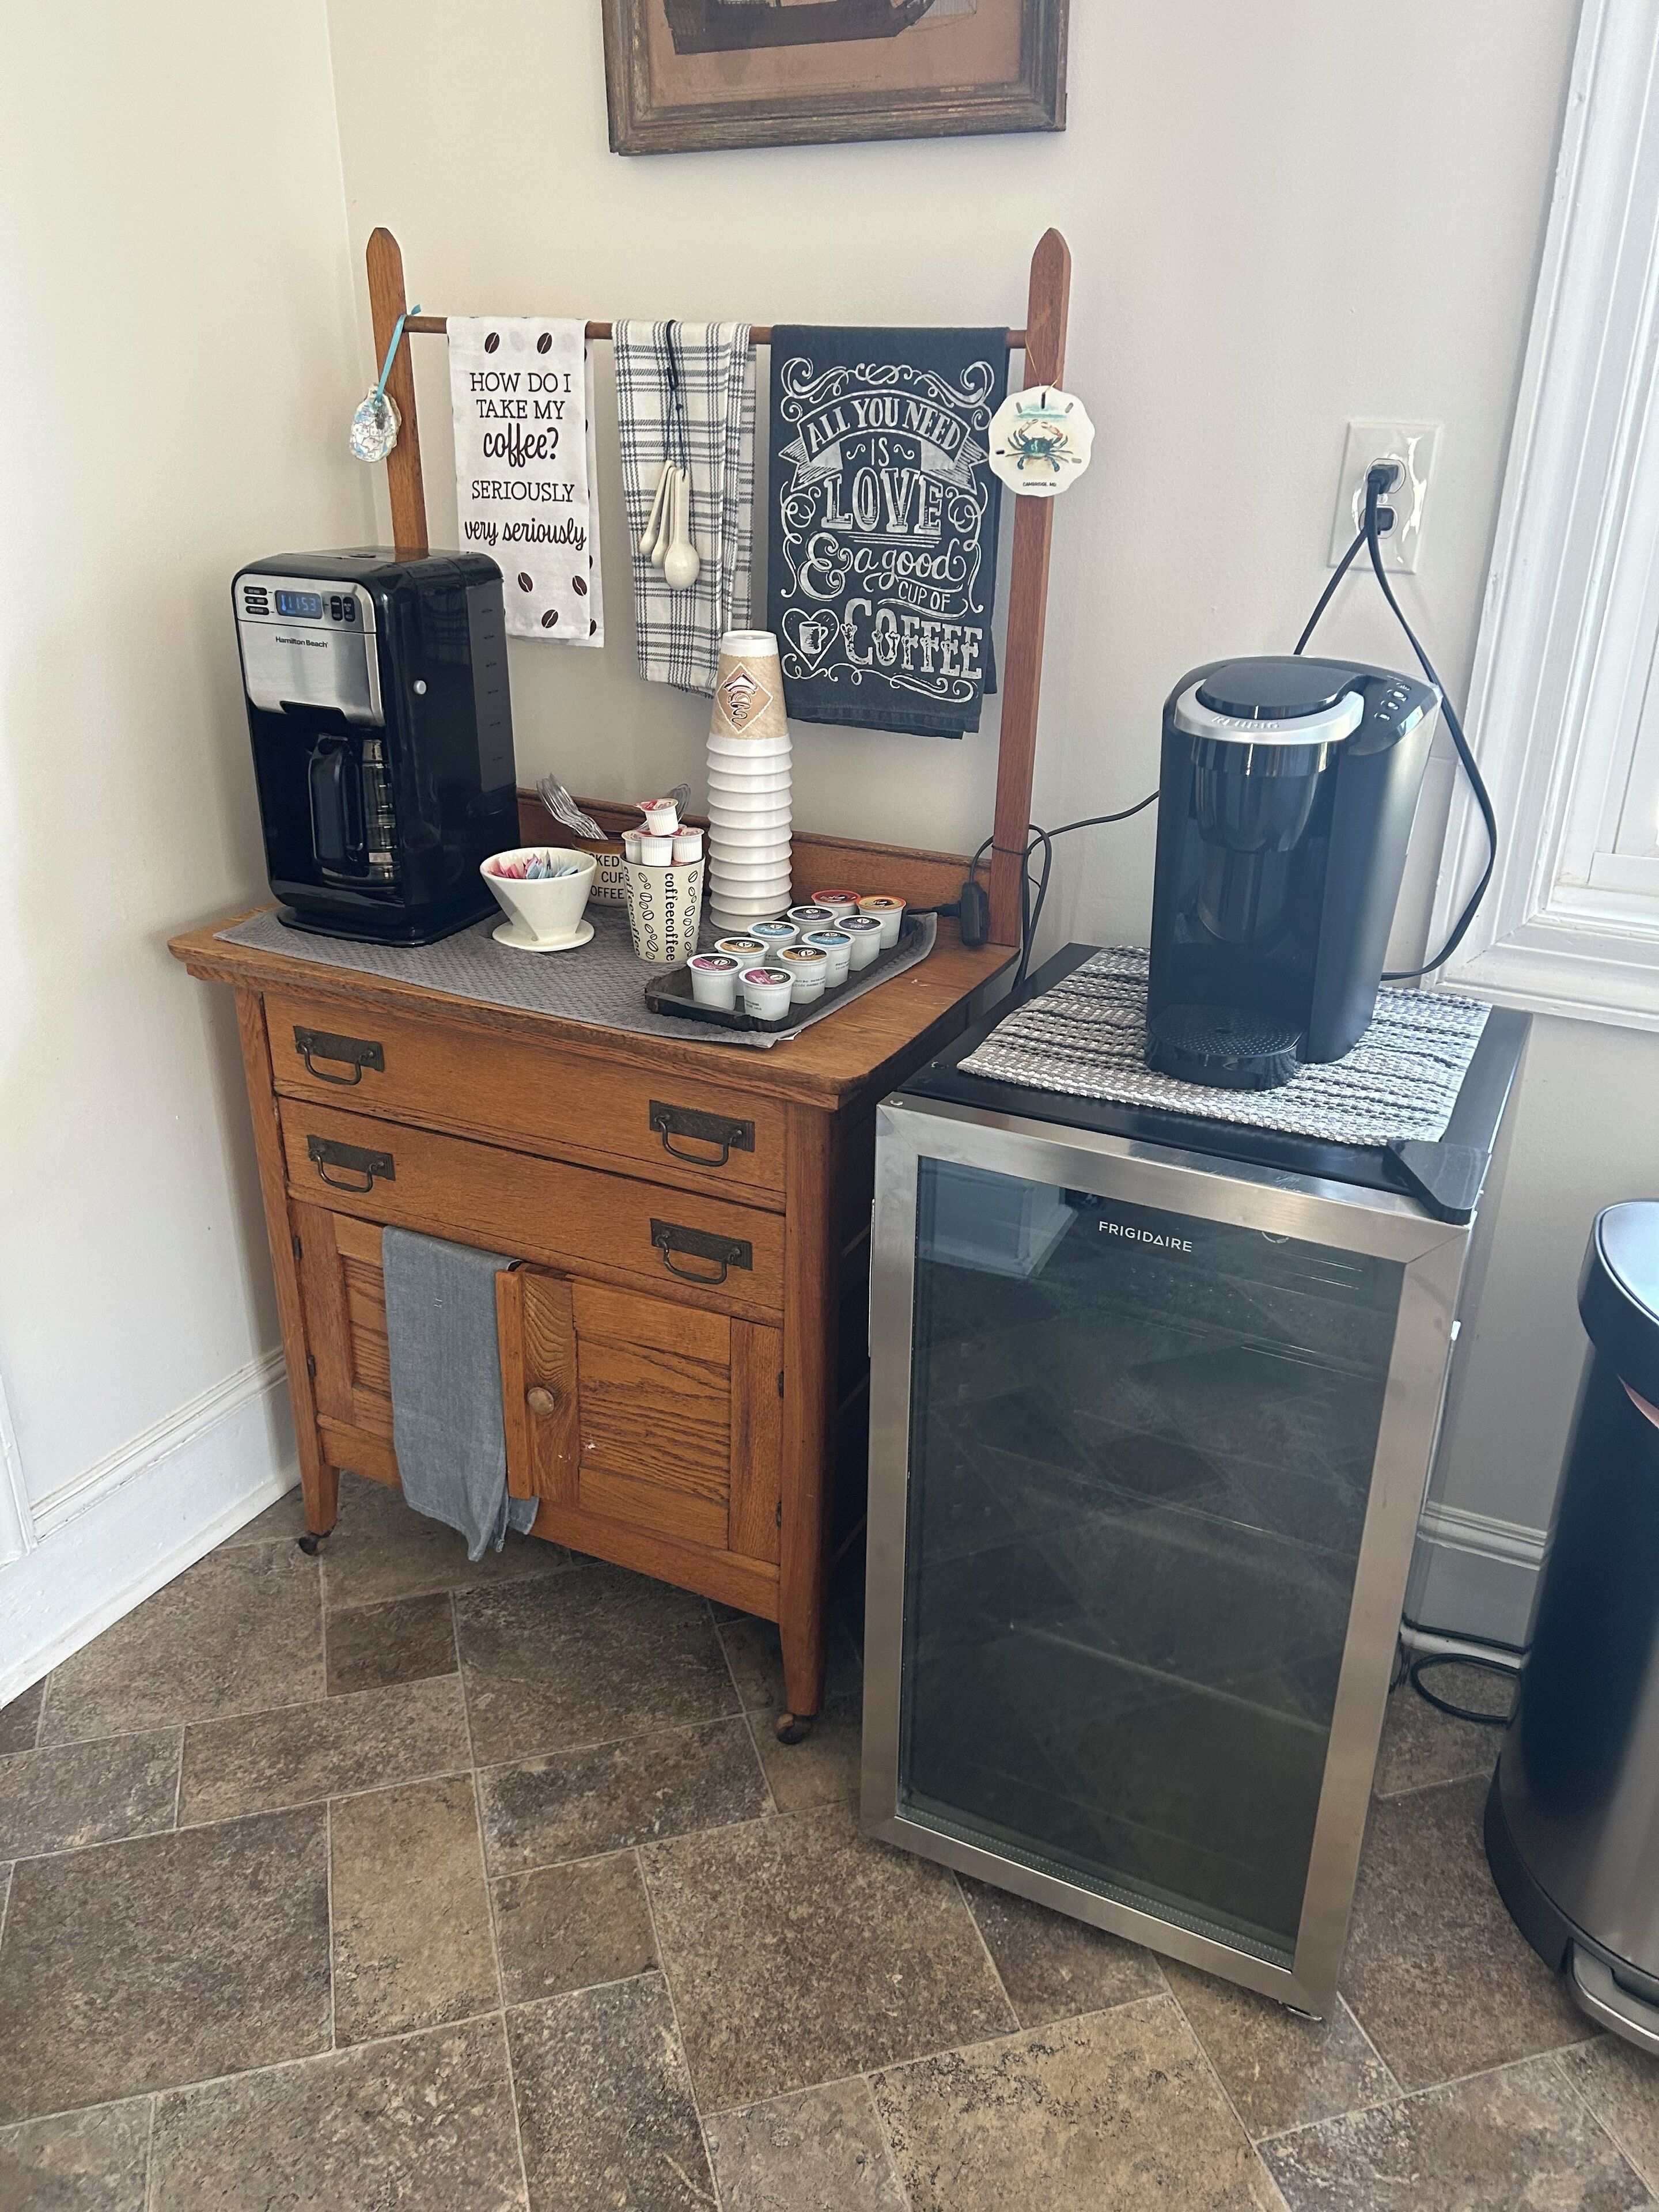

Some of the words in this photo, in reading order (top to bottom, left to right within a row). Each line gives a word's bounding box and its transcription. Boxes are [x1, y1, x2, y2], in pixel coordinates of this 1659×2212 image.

[469, 372, 521, 393] HOW
[528, 372, 558, 393] DO
[563, 373, 571, 393] I
[476, 399, 528, 419] TAKE
[533, 400, 566, 420] MY
[806, 407, 851, 453] ALL
[850, 397, 900, 428] YOU
[902, 400, 961, 450] NEED
[483, 422, 559, 468] coffee?
[871, 437, 891, 467] IS
[472, 480, 575, 502] SERIOUSLY
[821, 467, 944, 536] LOVE
[464, 521, 499, 547] very
[502, 517, 587, 551] seriously
[854, 547, 880, 573] a
[879, 537, 967, 590] good
[897, 580, 928, 605] CUP
[930, 593, 951, 612] OF
[275, 636, 305, 646] Hamilton
[305, 639, 327, 648] Beach
[840, 597, 983, 680] COFFEE
[590, 885, 625, 899] OFFEE
[1099, 1221, 1192, 1252] FRIGIDAIRE
